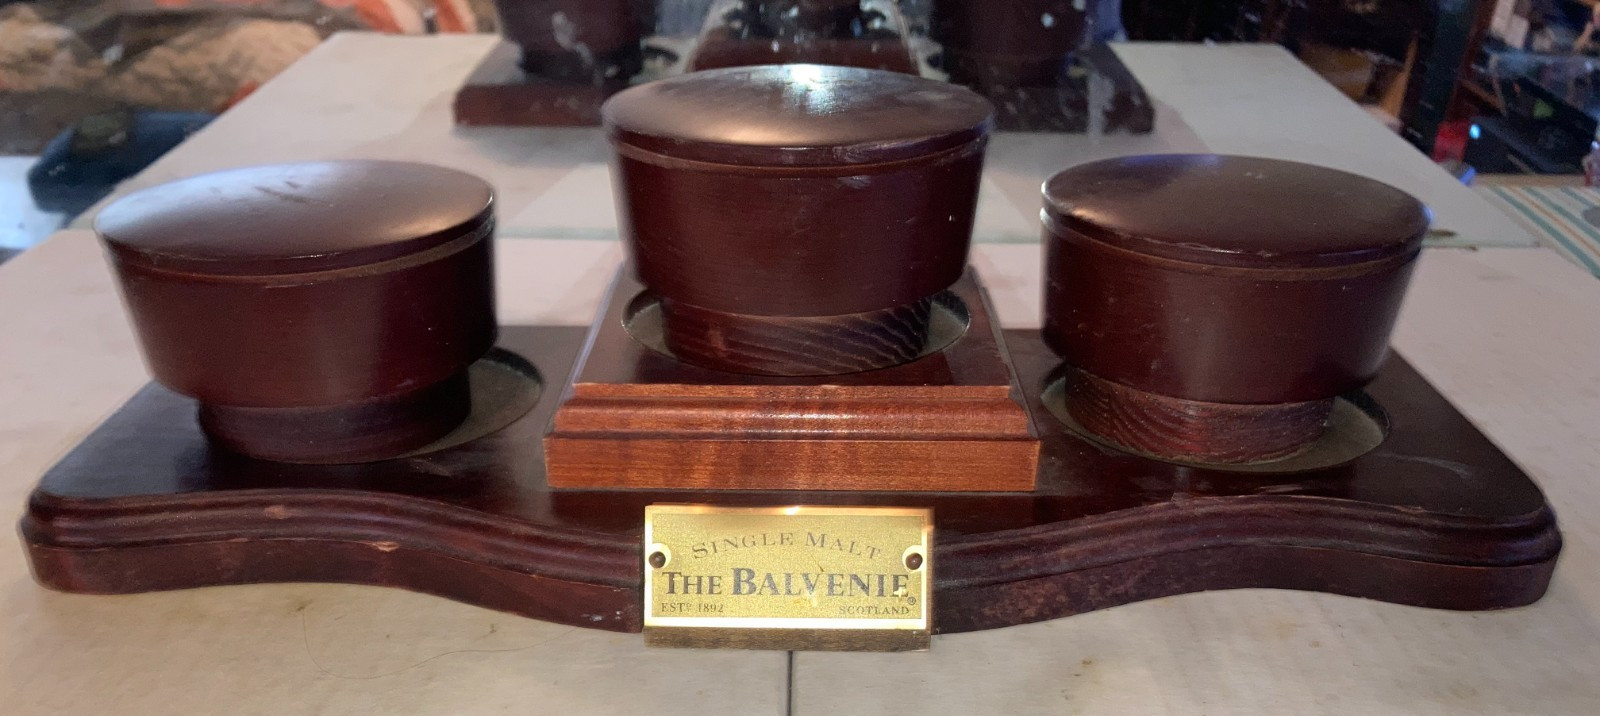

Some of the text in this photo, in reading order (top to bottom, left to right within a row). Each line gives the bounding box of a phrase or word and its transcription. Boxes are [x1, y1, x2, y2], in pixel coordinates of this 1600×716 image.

[691, 531, 882, 560] SINGLE MALT
[661, 571, 723, 595] THE
[697, 602, 725, 614] 1892
[839, 605, 911, 616] SCOTLAND
